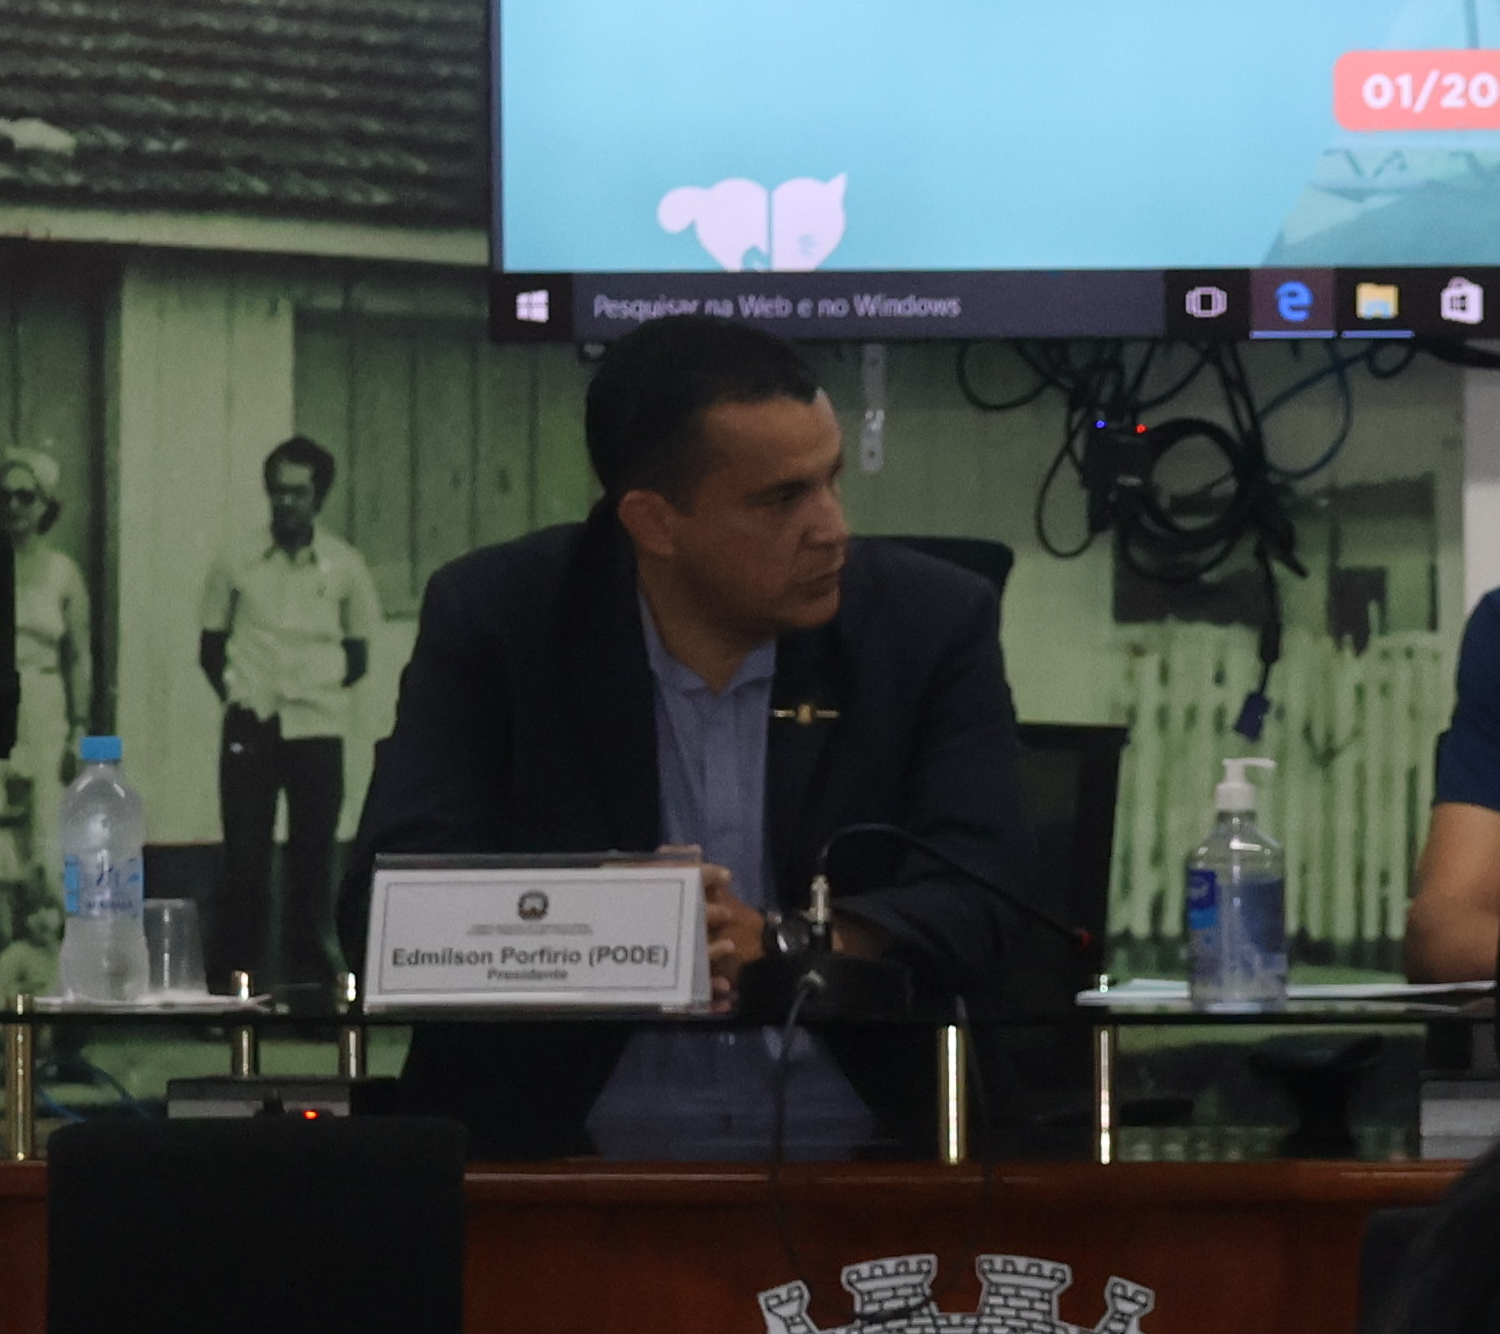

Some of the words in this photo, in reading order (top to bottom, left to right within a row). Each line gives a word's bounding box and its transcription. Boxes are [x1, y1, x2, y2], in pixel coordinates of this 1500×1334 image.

[594, 294, 699, 322] Pesquisar
[705, 298, 735, 318] na
[738, 294, 794, 318] Web
[797, 298, 814, 318] e
[817, 298, 850, 318] no
[853, 294, 962, 318] Windows
[392, 947, 493, 967] Edmilson
[588, 945, 670, 968] (PODE)
